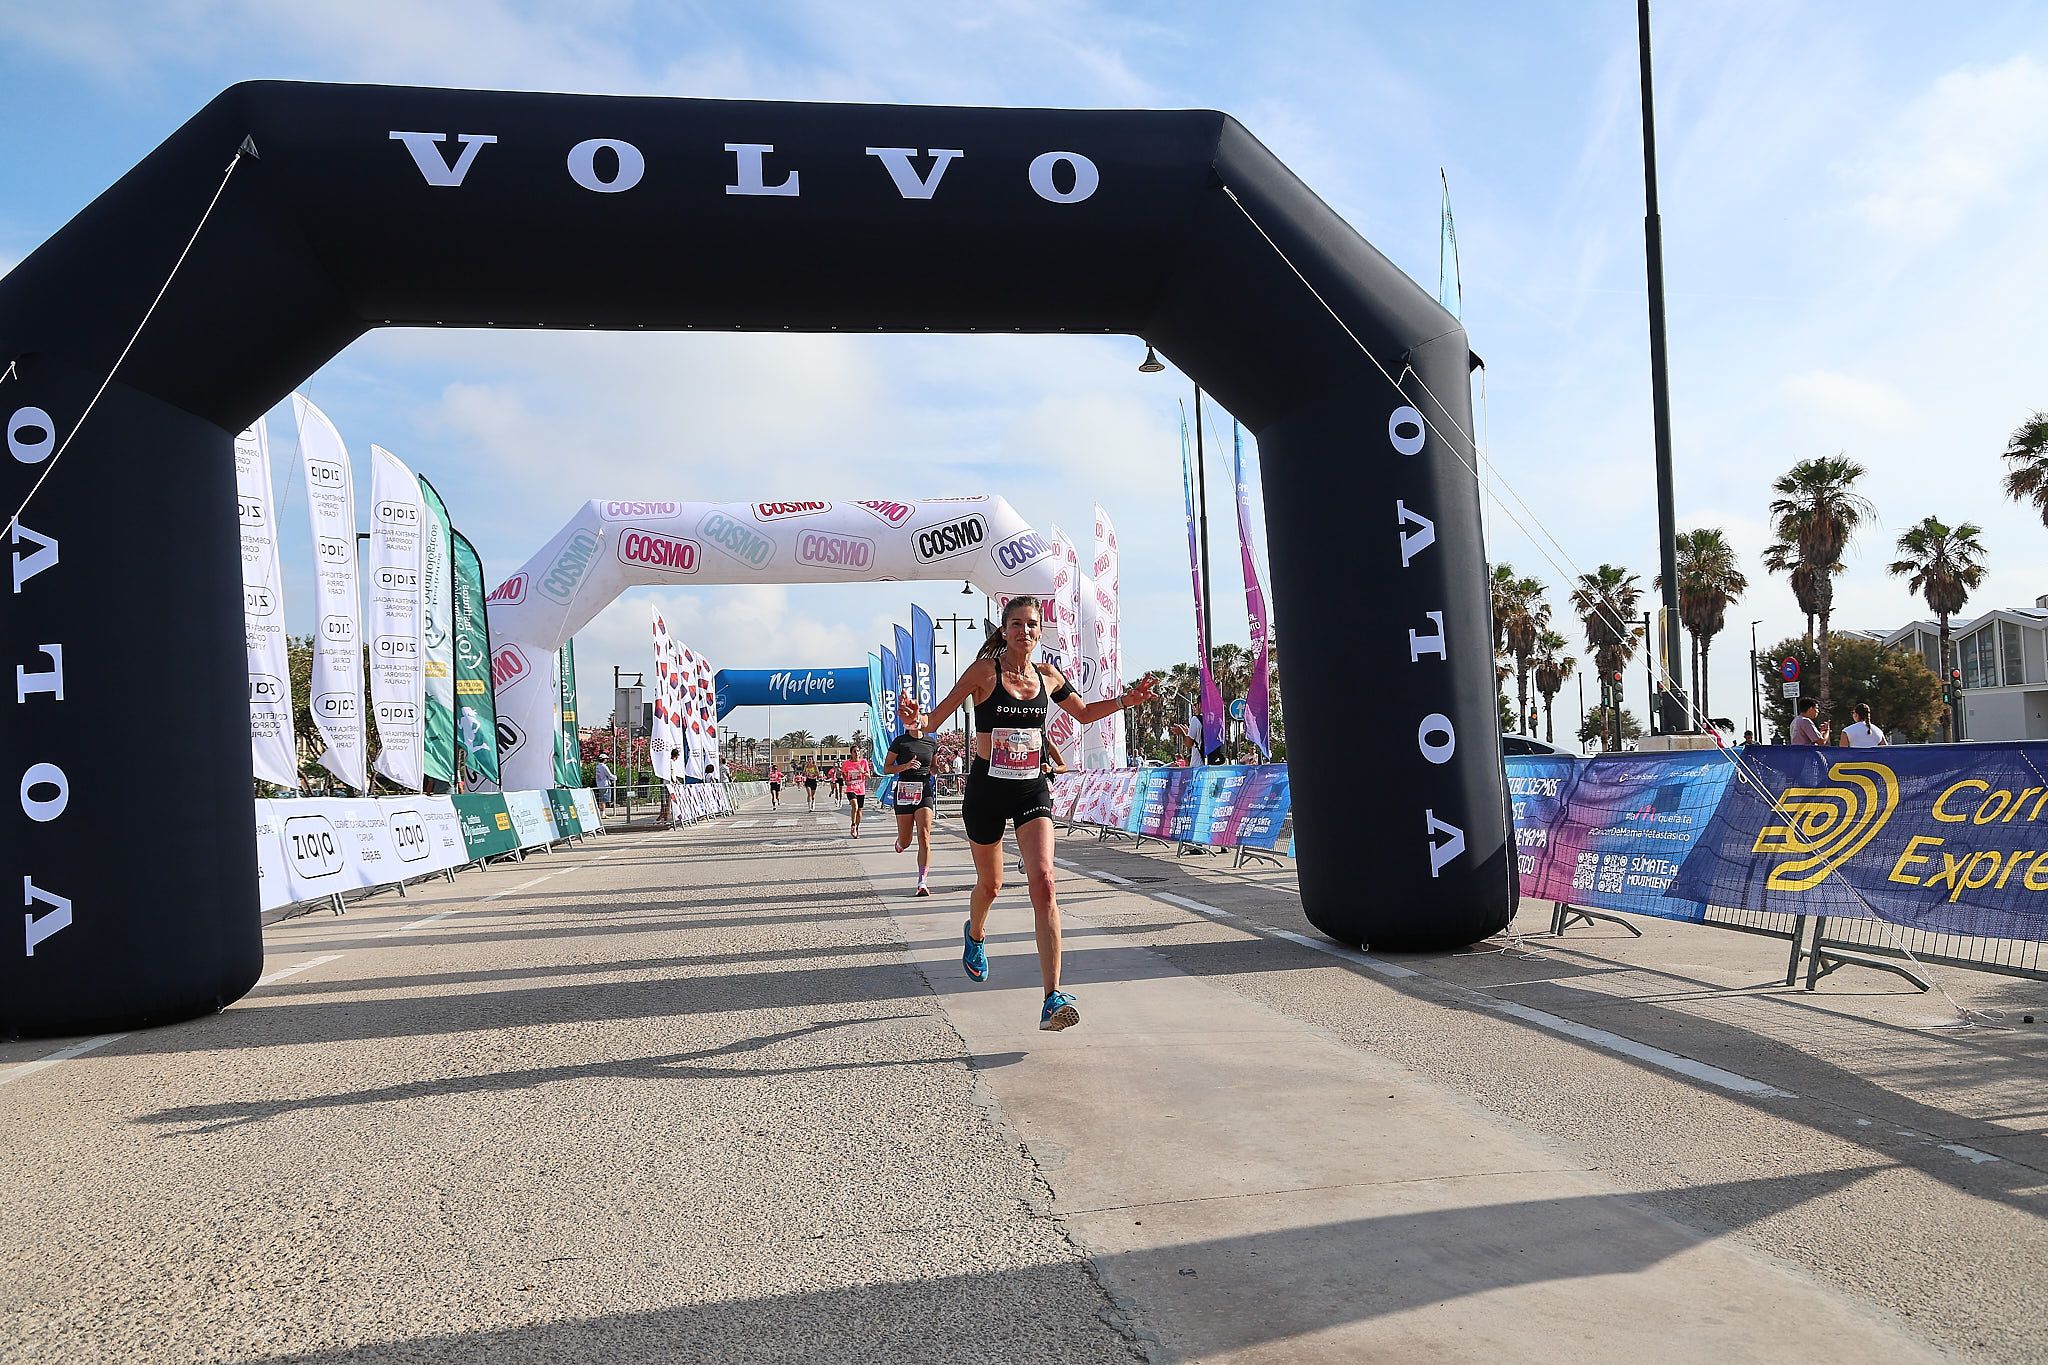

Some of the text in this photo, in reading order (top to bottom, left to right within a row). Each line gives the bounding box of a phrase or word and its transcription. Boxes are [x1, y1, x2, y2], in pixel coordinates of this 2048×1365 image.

[390, 131, 1099, 203] VOLVO
[625, 533, 694, 570] COSMO
[703, 514, 770, 565] COSMO
[802, 534, 869, 567] COSMO
[919, 518, 984, 559] COSMO
[543, 534, 600, 598] COSMO
[1389, 406, 1466, 877] VOLVO
[7, 406, 73, 956] VOLVO
[996, 705, 1047, 715] SOULCYCLE
[1009, 752, 1028, 761] 016
[292, 831, 336, 868] ziaja
[395, 824, 425, 853] ziaja
[1631, 854, 1670, 875] SÚMATE
[1888, 835, 2048, 903] Expre
